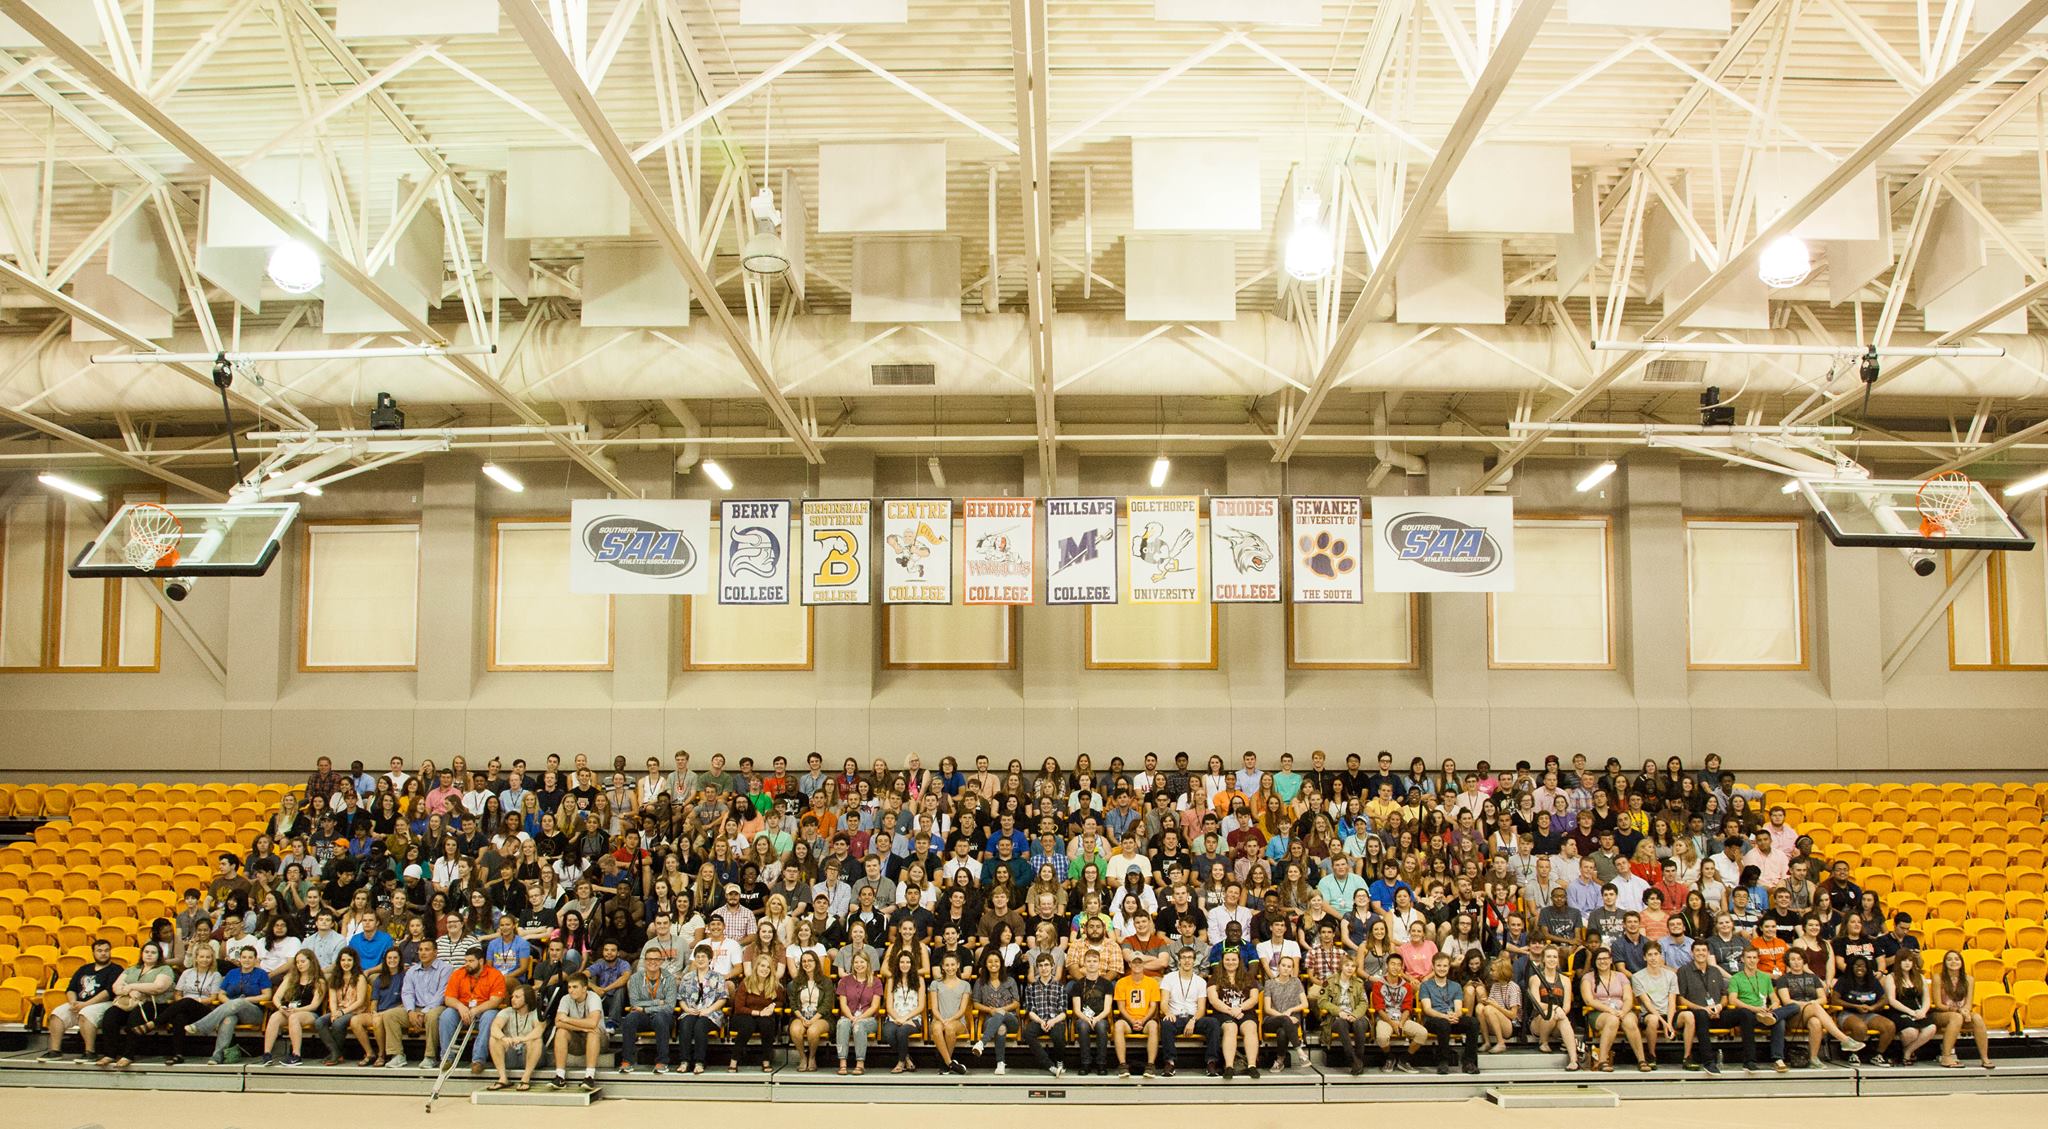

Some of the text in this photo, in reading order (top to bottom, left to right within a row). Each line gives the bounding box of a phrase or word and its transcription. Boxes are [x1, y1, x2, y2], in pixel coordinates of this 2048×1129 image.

[732, 503, 780, 519] BERRY
[804, 502, 869, 516] BIRMINGHAM
[887, 502, 948, 520] CENTRE
[967, 502, 1032, 518] HENDRIX
[1050, 501, 1113, 516] MILLSAPS
[1131, 501, 1195, 513] OGLETHORPE
[1216, 501, 1274, 517] RHODES
[1295, 501, 1358, 515] SEWANEE
[809, 515, 863, 526] SOUTHERN
[1296, 516, 1358, 525] UNIVERSITY OF
[594, 529, 683, 562] SAA
[1057, 528, 1099, 570] M
[1398, 527, 1487, 560] SAA
[724, 586, 783, 601] COLLEGE
[813, 590, 858, 602] COLLEGE
[888, 586, 946, 601] COLLEGE
[969, 586, 1029, 602] COLLEGE
[1054, 586, 1111, 601] COLLEGE
[1134, 588, 1196, 600] UNIVERSITY
[1216, 584, 1276, 600] COLLEGE
[1302, 589, 1353, 600] THE SOUTH
[1131, 990, 1142, 1004] FJ
